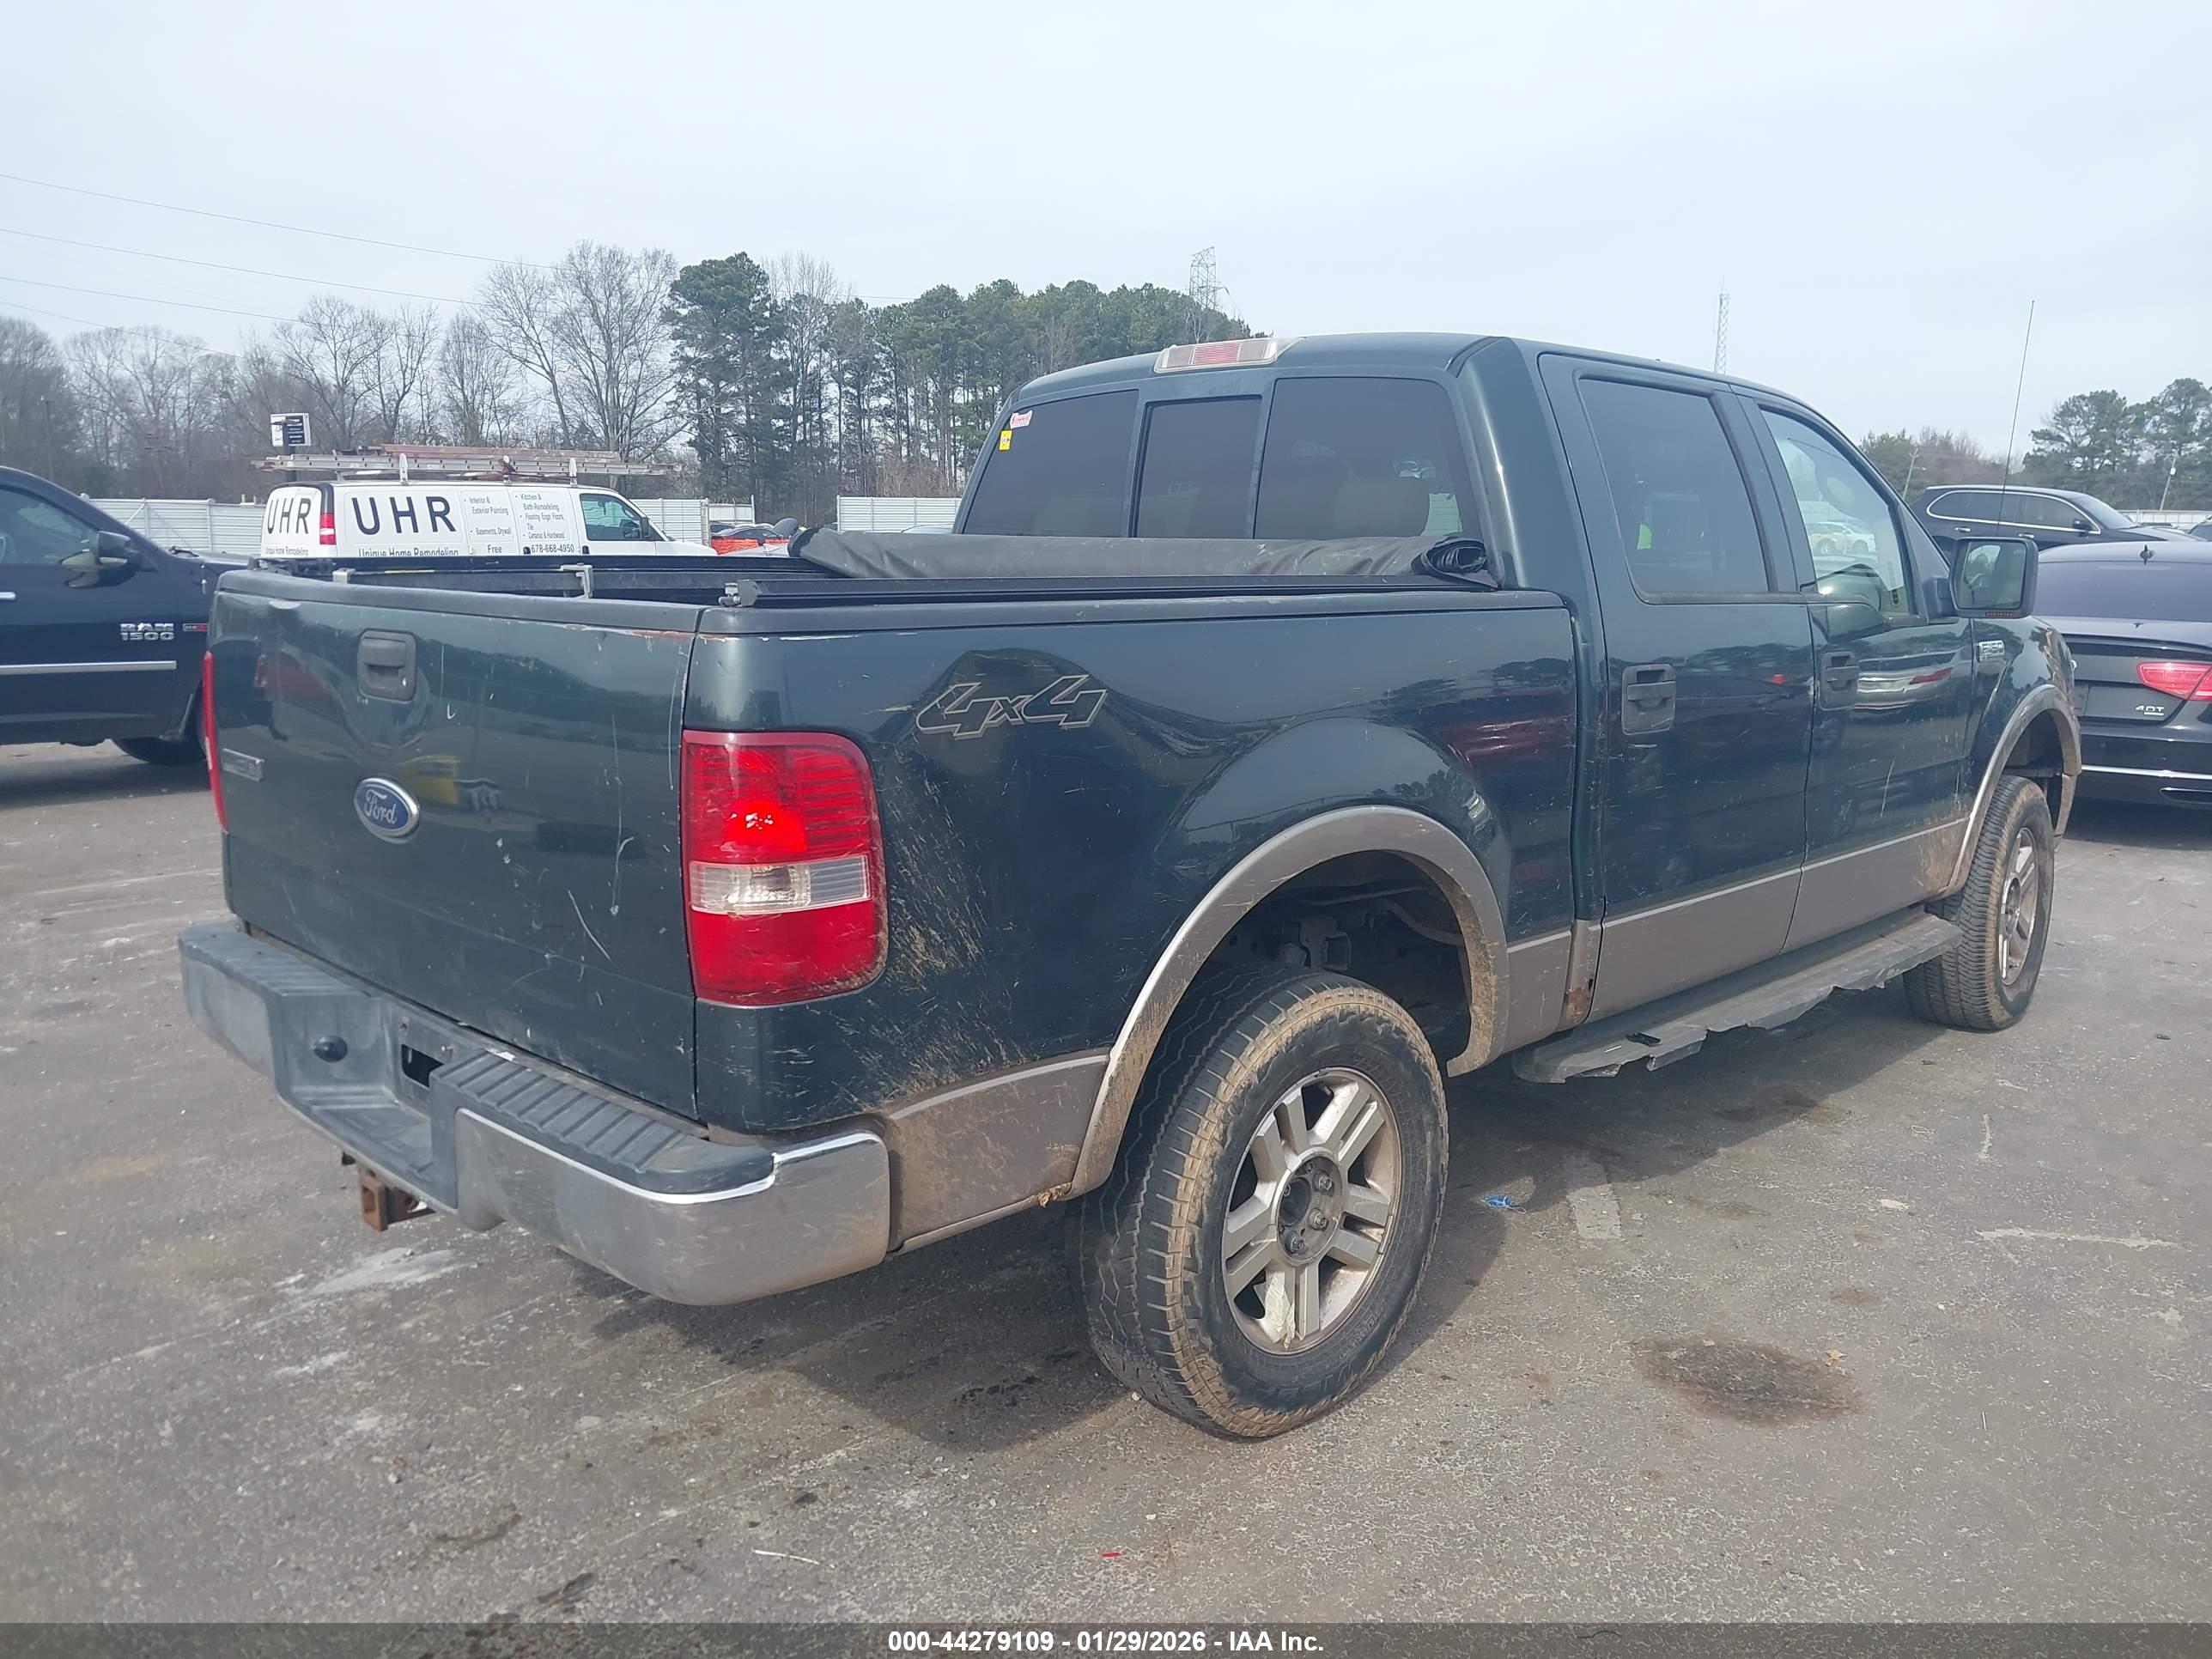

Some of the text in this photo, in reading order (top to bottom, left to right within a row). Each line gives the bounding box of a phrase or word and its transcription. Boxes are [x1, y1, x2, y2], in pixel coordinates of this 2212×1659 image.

[267, 497, 311, 534] UHR
[351, 495, 457, 535] UHR
[487, 544, 502, 554] Free
[531, 544, 574, 553] 678-668-4950
[120, 623, 174, 632] RAM
[120, 631, 175, 641] 1500
[915, 674, 1109, 740] 4x4
[364, 789, 396, 824] Ford
